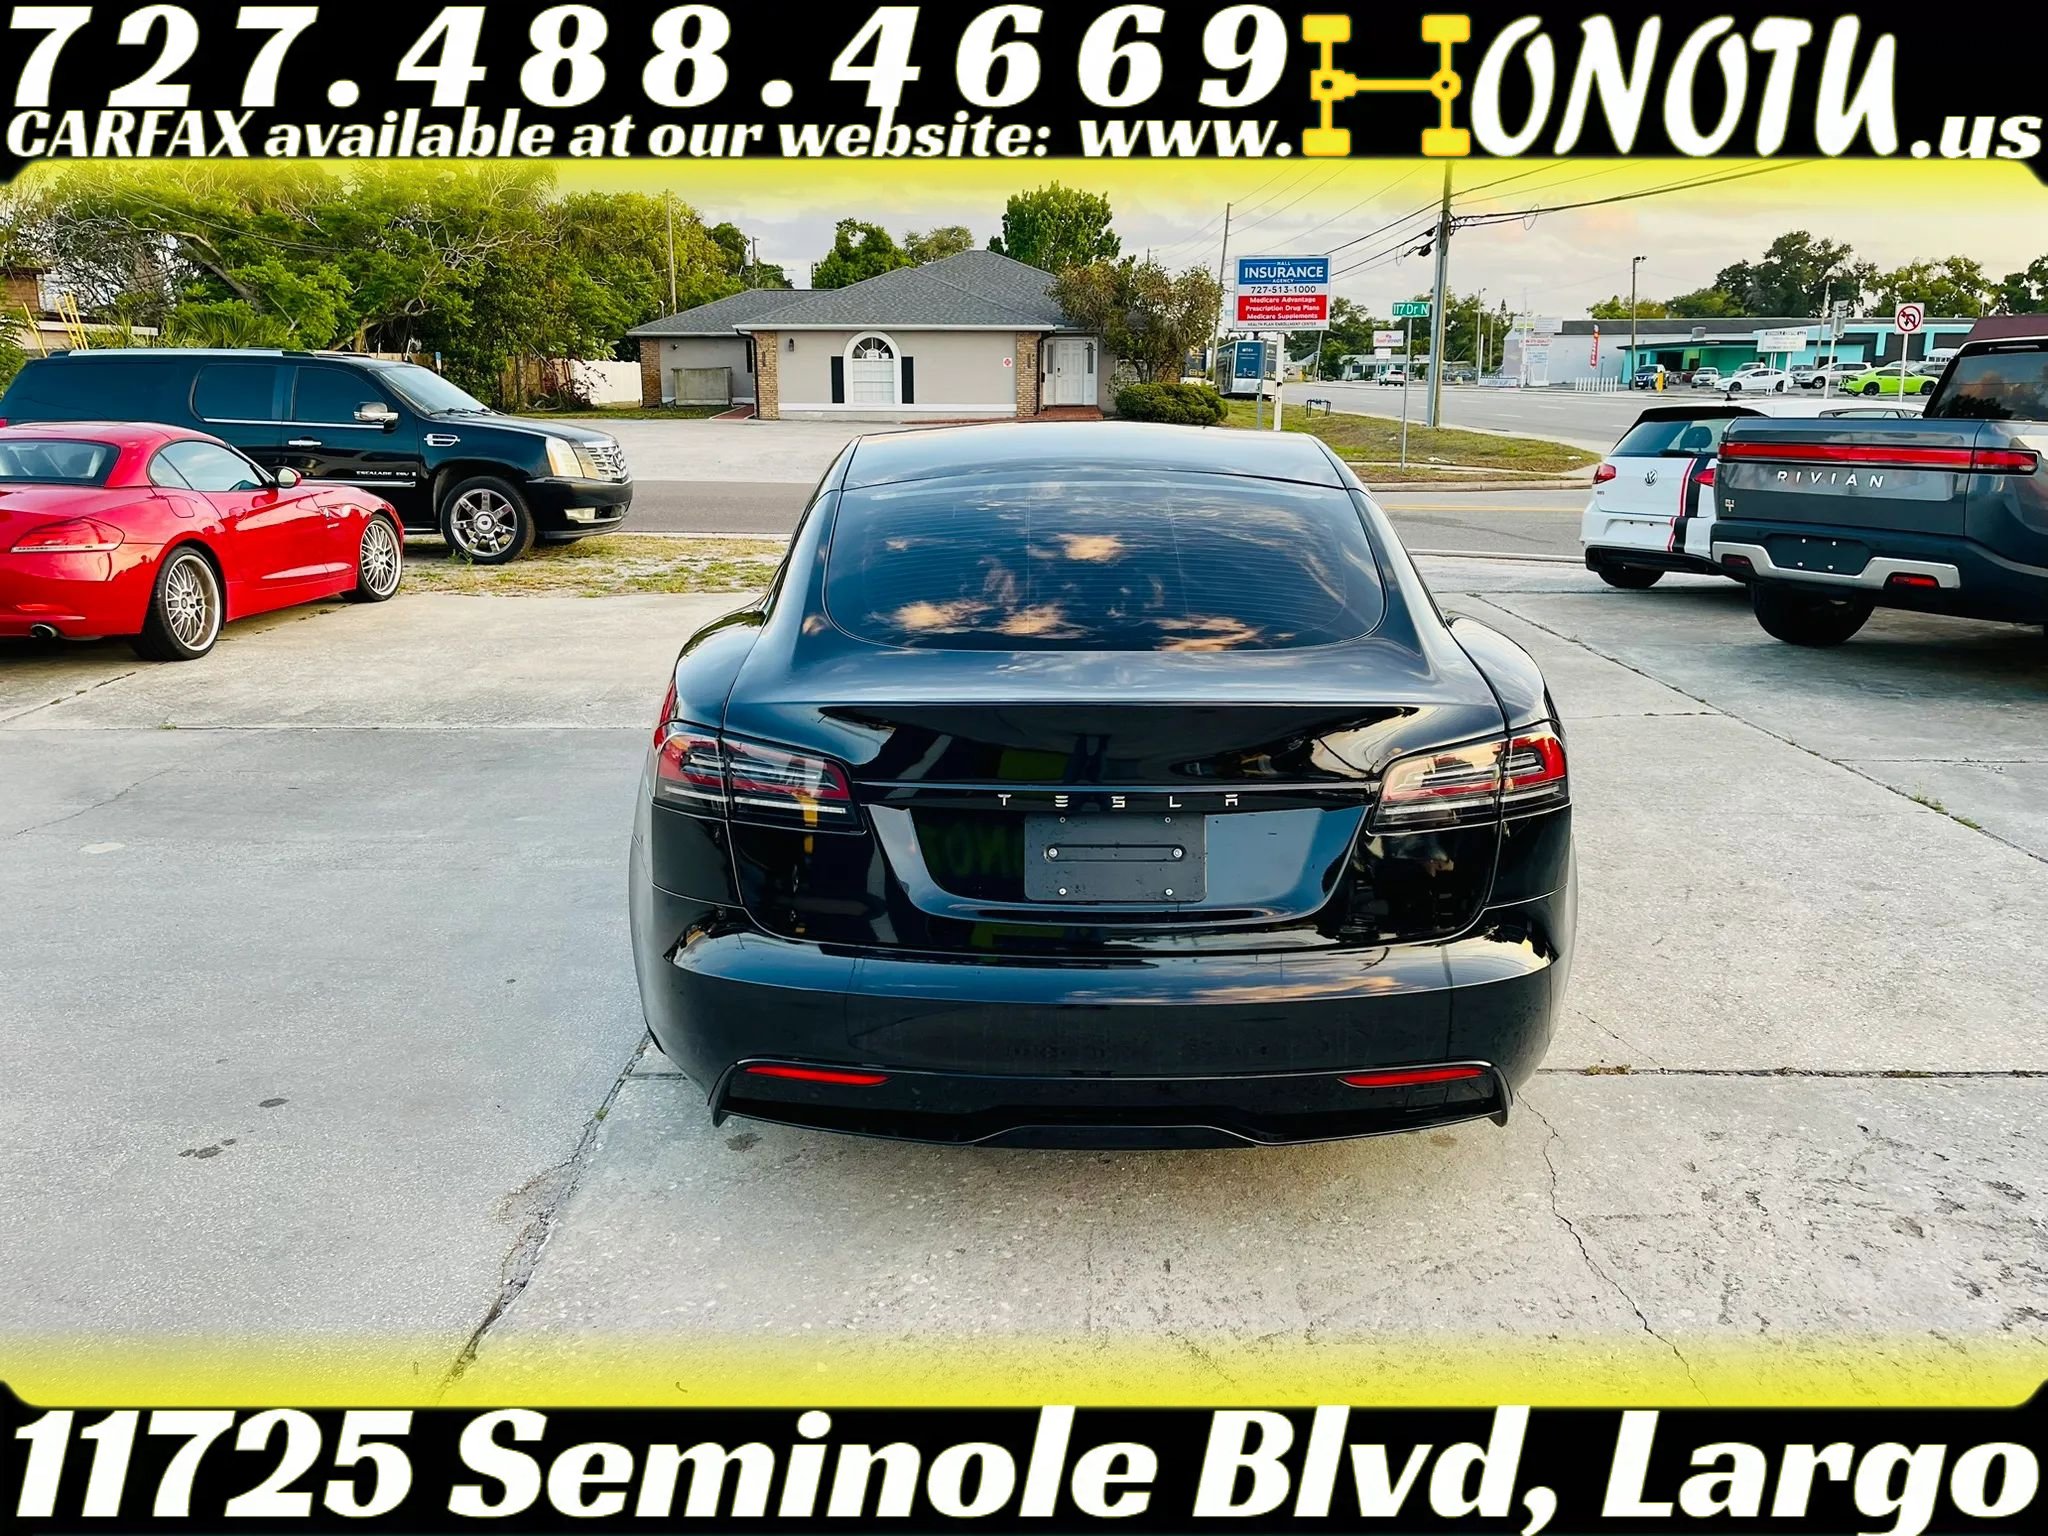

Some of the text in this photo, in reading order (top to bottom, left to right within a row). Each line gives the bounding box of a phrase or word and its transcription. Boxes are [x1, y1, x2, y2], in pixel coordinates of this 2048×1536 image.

[1244, 266, 1324, 279] INSURANCE
[1250, 285, 1317, 294] 727-513-1000
[1406, 304, 1418, 315] Dr
[1420, 304, 1428, 315] N
[1777, 470, 1884, 488] RIVIAN
[997, 793, 1239, 808] TESLA
